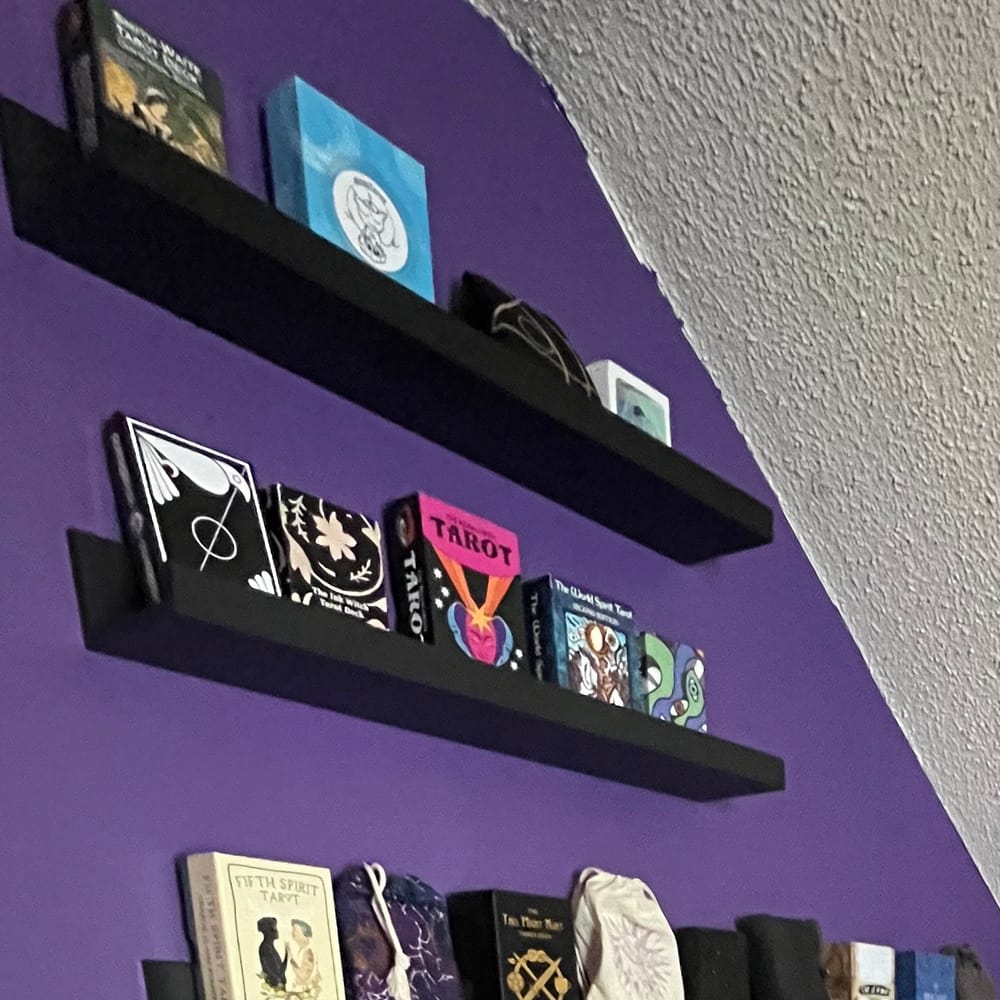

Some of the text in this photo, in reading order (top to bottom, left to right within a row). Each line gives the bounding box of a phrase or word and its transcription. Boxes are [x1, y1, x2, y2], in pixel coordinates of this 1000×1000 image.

[430, 515, 512, 567] TAROT
[311, 586, 370, 612] The Ink Witch
[319, 597, 366, 620] Tarot Deck
[403, 549, 424, 643] TARO
[554, 578, 633, 620] The World Spirit Tarot
[235, 875, 320, 897] FIFTH SPIRIT
[259, 889, 300, 905] TAROT
